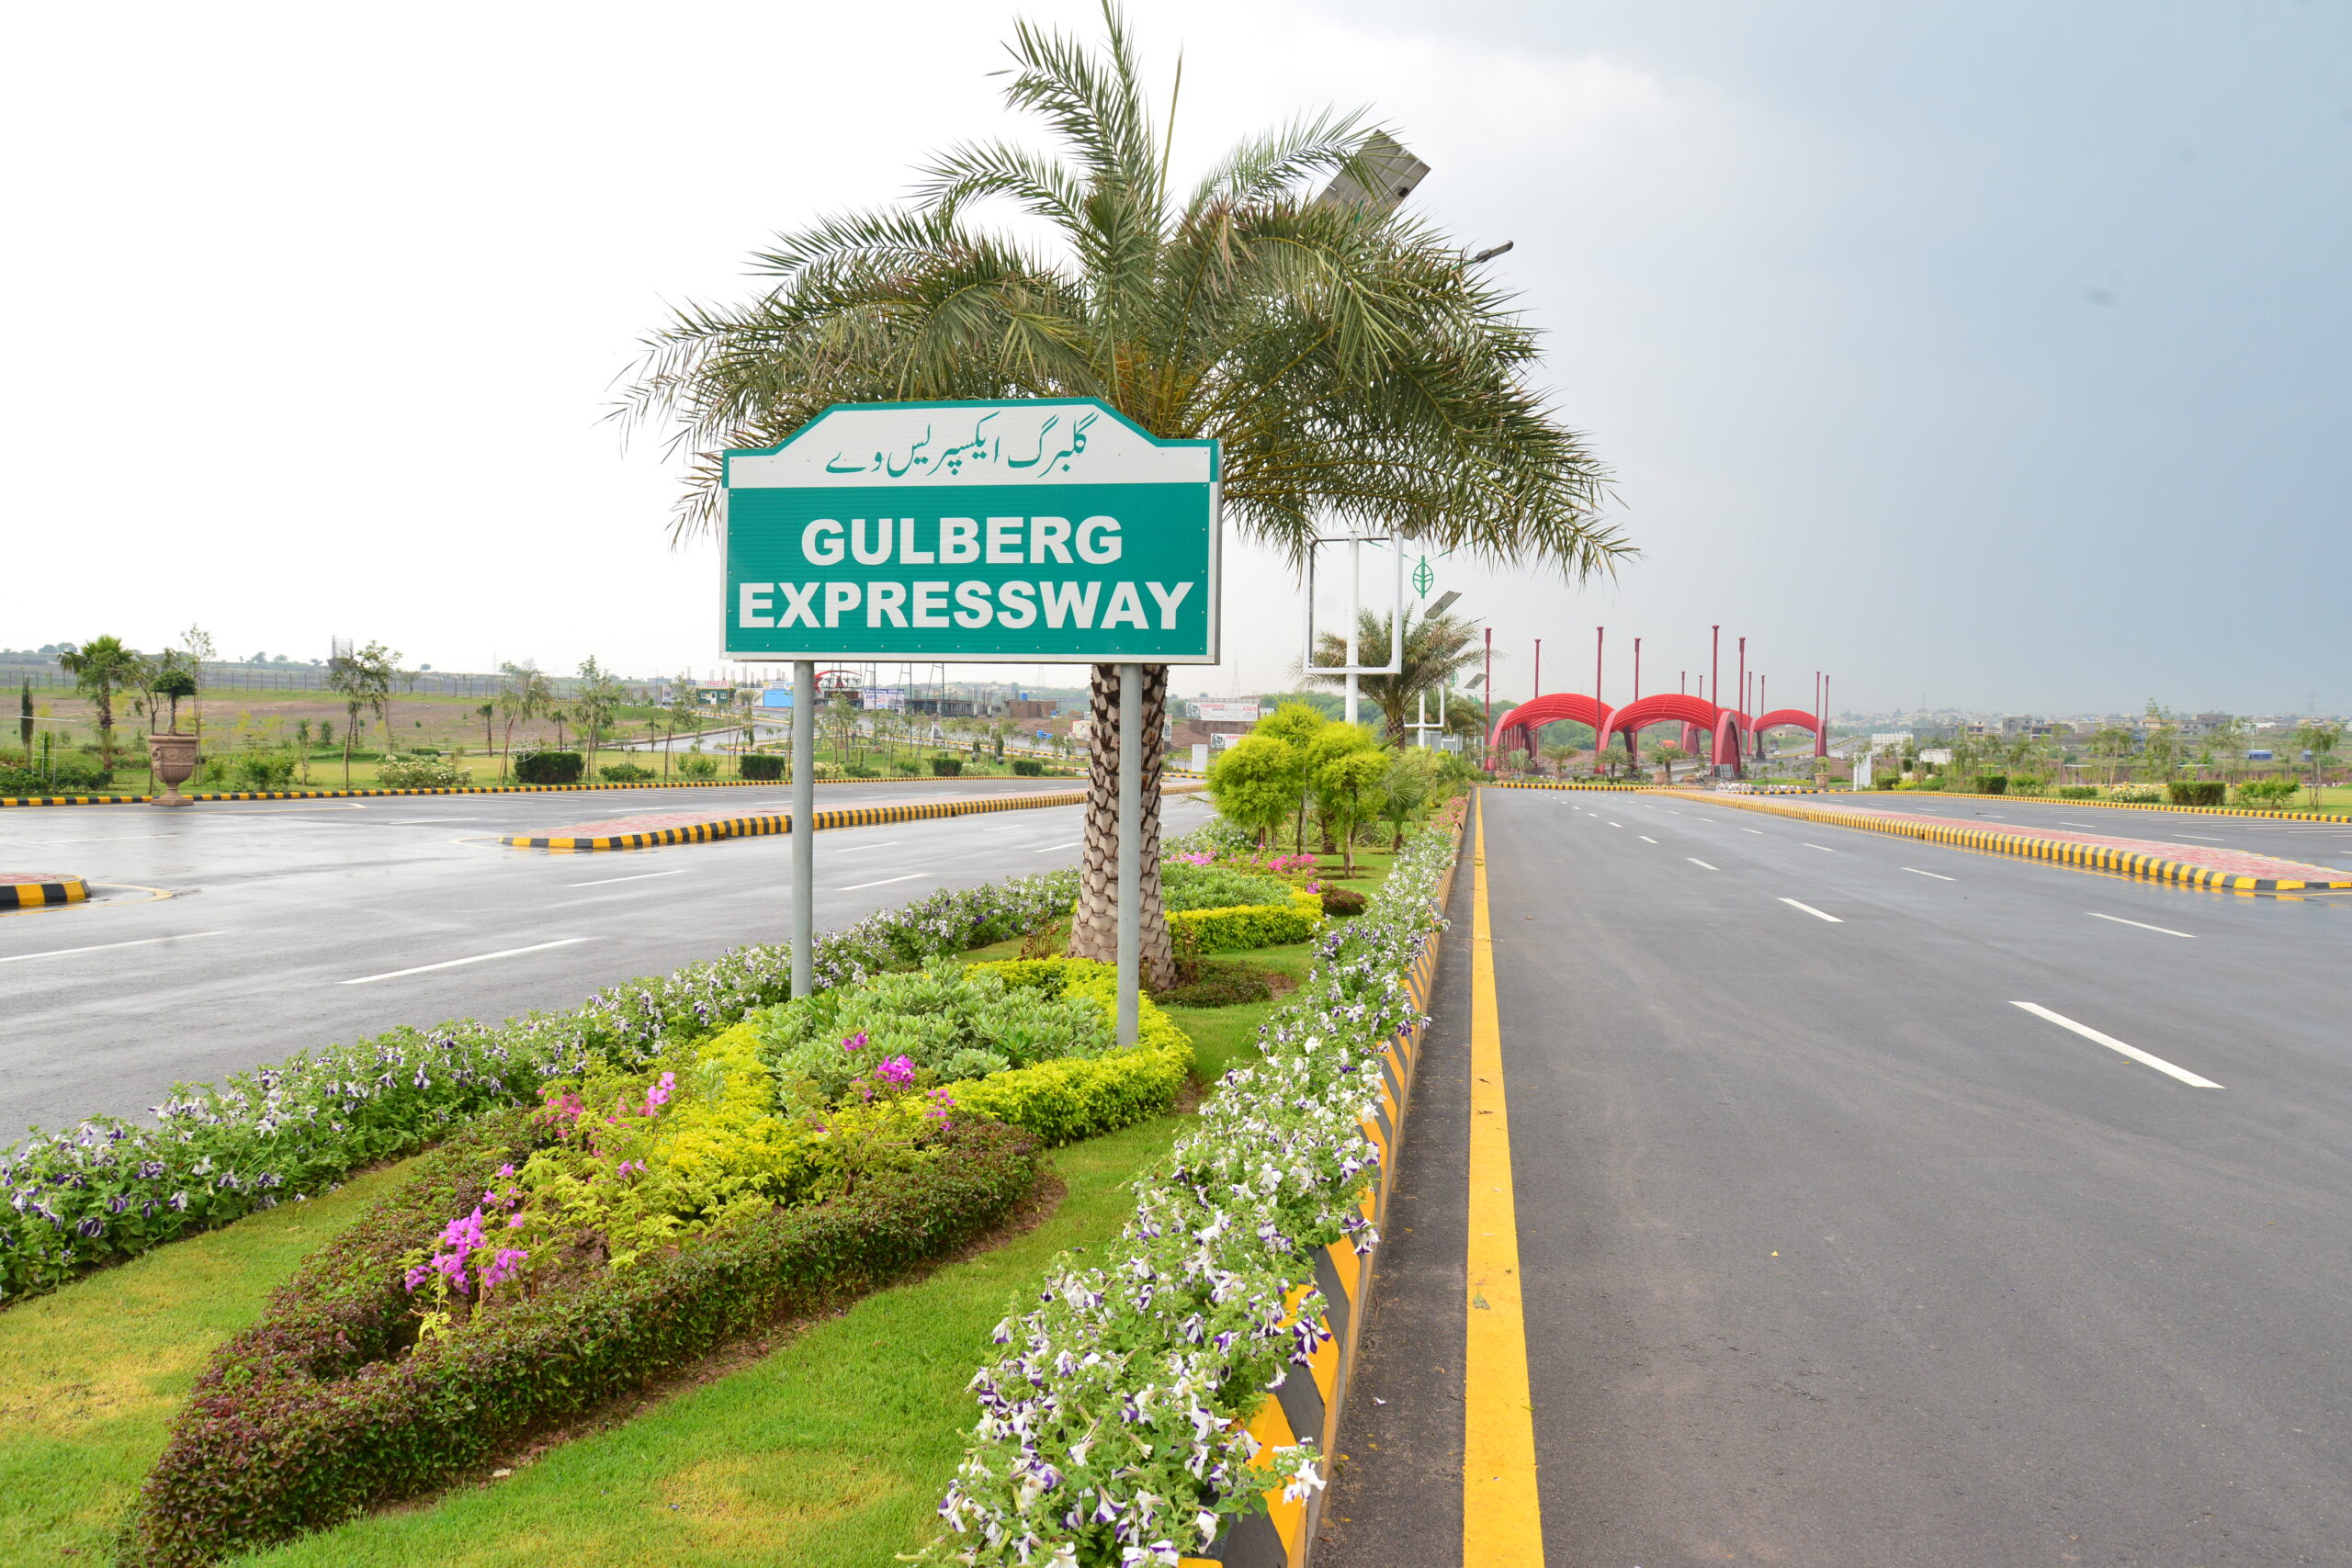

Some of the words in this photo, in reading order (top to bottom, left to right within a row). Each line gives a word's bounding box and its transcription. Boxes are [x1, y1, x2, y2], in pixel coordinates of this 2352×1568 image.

[1008, 411, 1100, 479] گلبرگ
[801, 515, 1123, 566] GULBERG
[739, 581, 1193, 630] EXPRESSWAY
